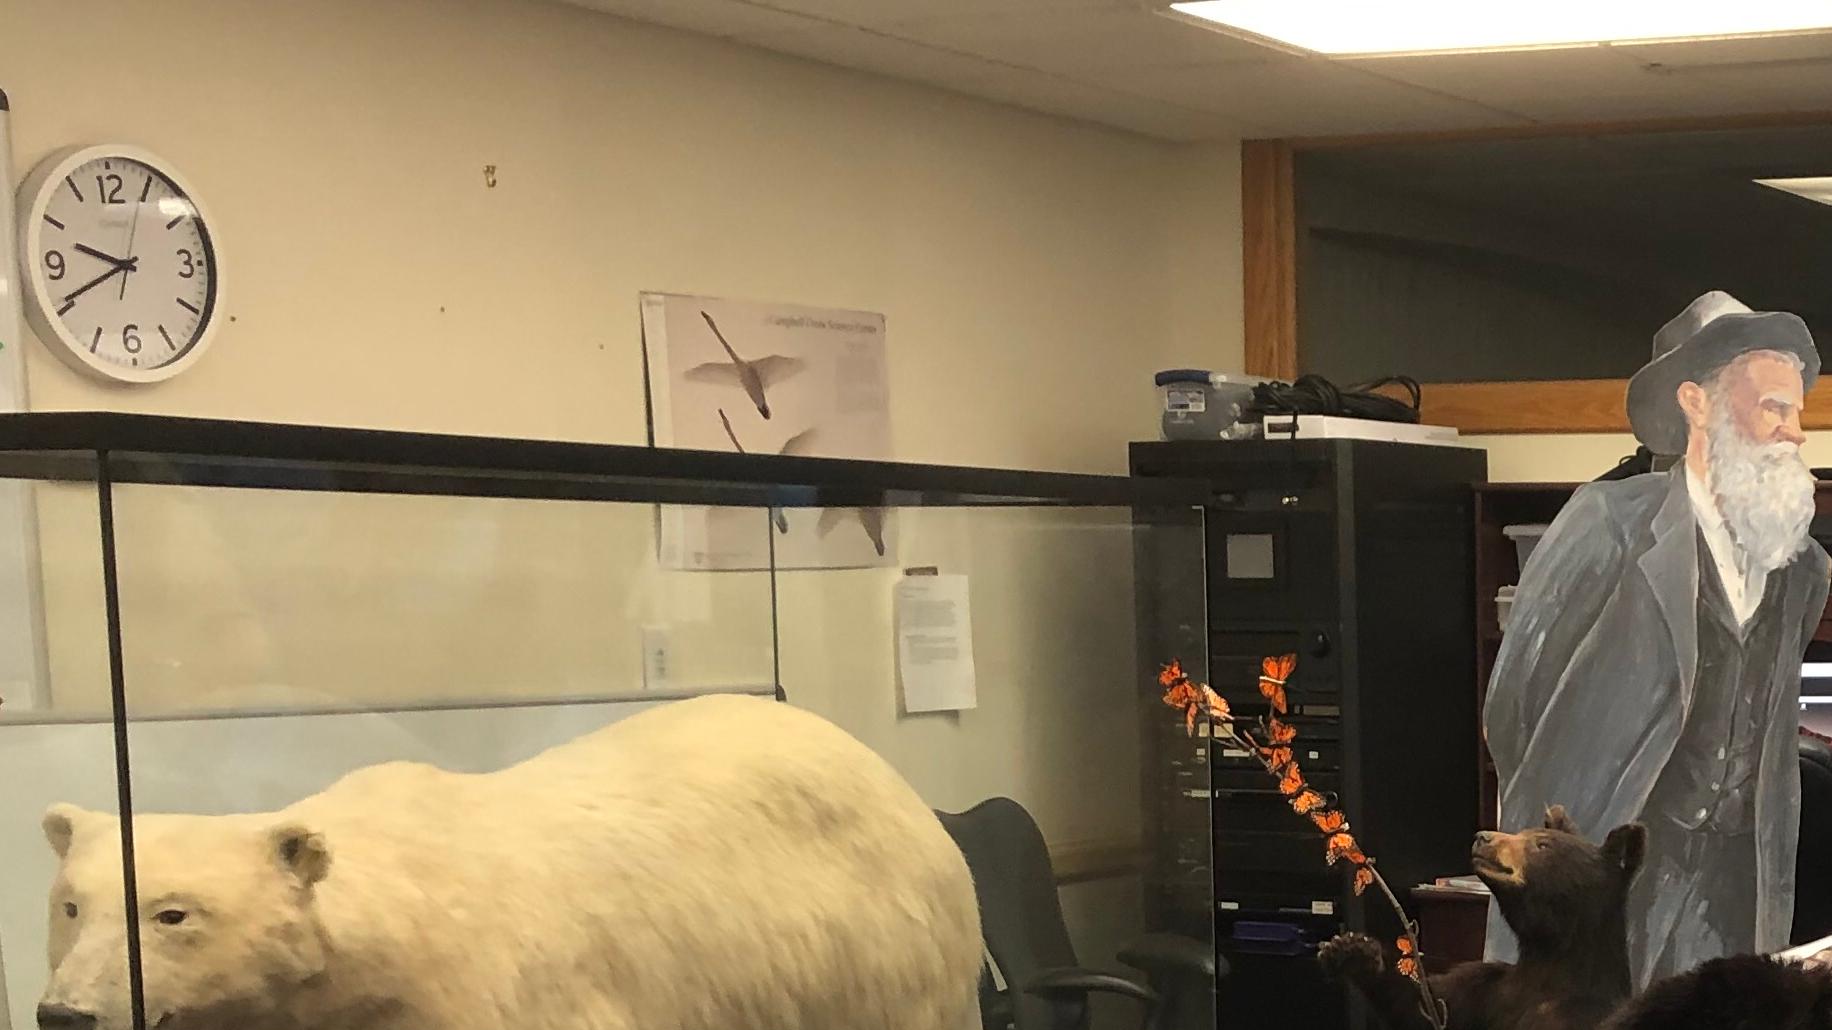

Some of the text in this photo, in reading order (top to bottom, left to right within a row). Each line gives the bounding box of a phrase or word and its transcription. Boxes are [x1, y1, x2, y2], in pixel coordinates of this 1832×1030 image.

[96, 174, 126, 204] 12
[44, 250, 65, 280] 9
[176, 248, 195, 279] 3
[122, 324, 143, 354] 6
